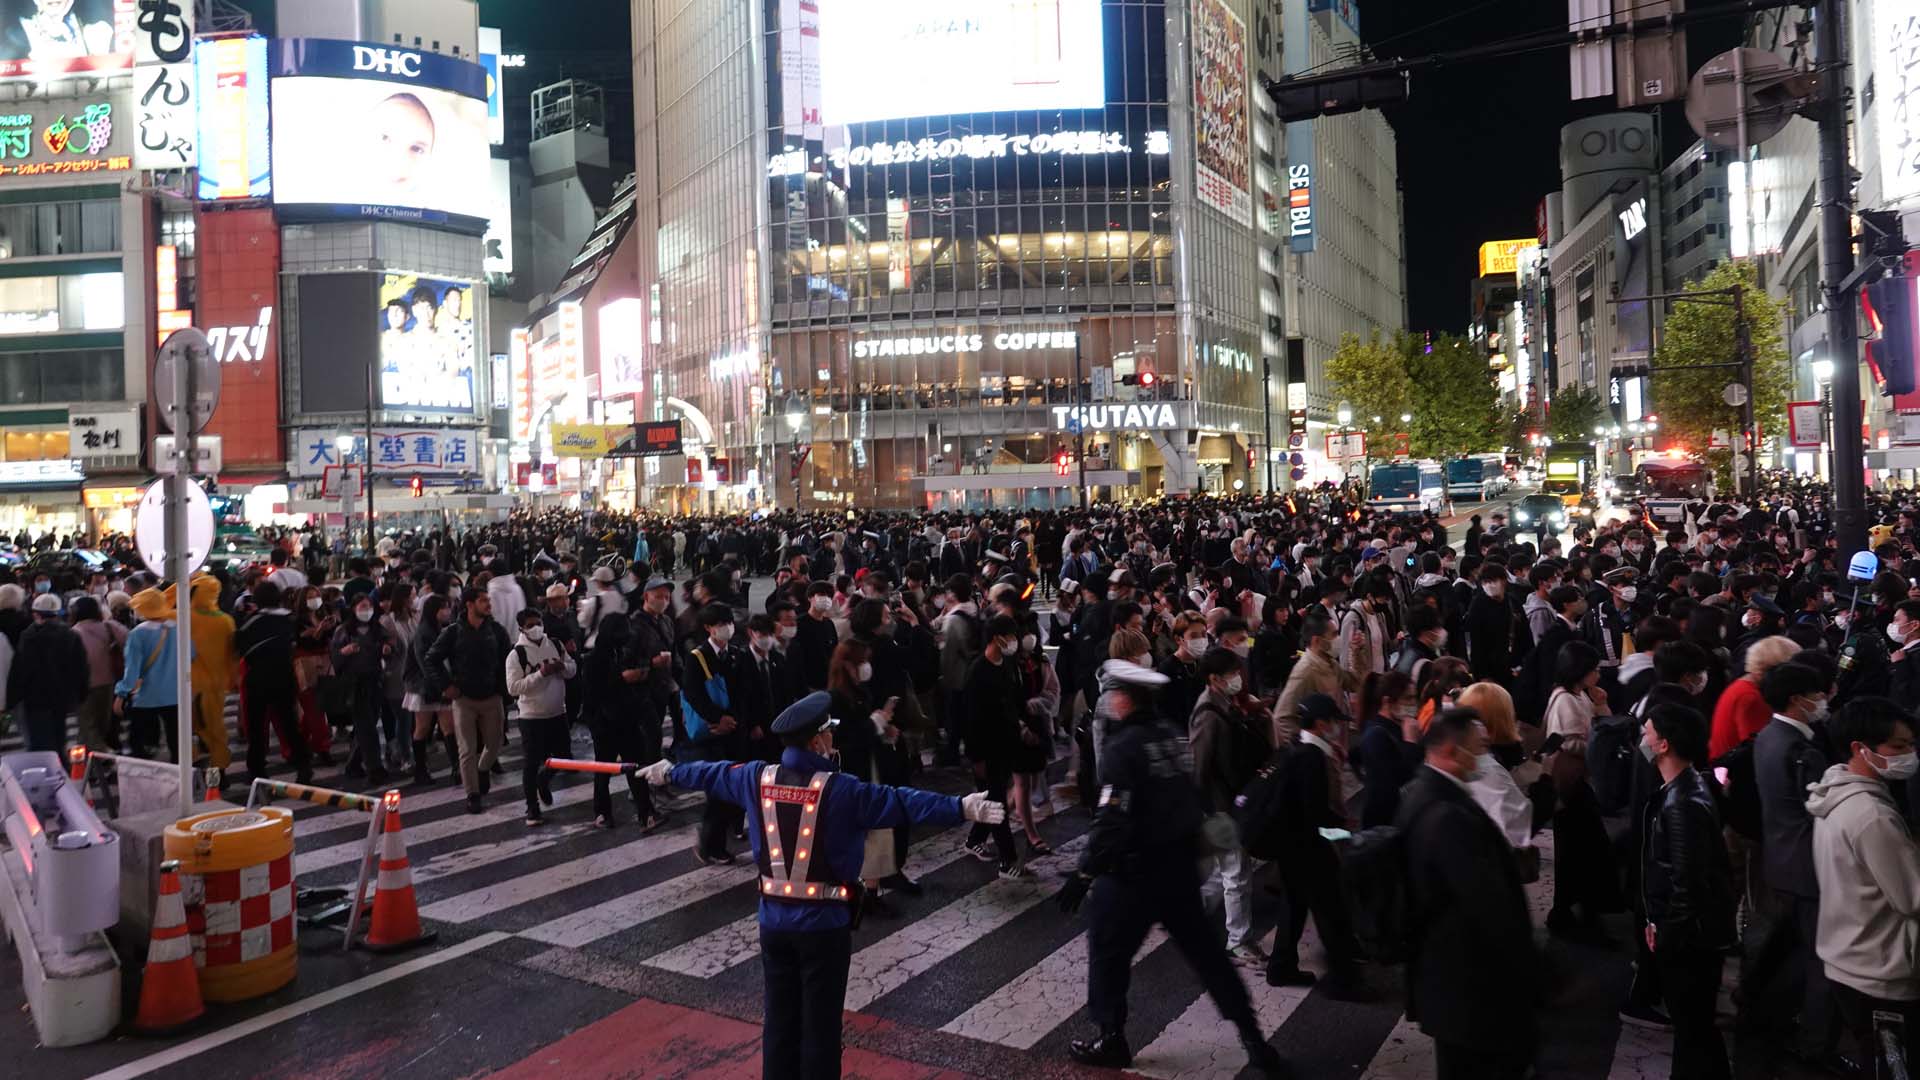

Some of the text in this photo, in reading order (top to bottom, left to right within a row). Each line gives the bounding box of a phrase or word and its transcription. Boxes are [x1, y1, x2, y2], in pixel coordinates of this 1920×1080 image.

[353, 45, 422, 77] DHC
[138, 0, 193, 163] もんじゃ
[384, 207, 423, 218] Channel
[1289, 164, 1312, 236] SEIBU
[207, 306, 273, 362] クスリ
[854, 330, 1077, 358] STARBUCKS COFFEE
[1610, 377, 1621, 404] ZARA
[1053, 404, 1176, 431] TSUTAYA
